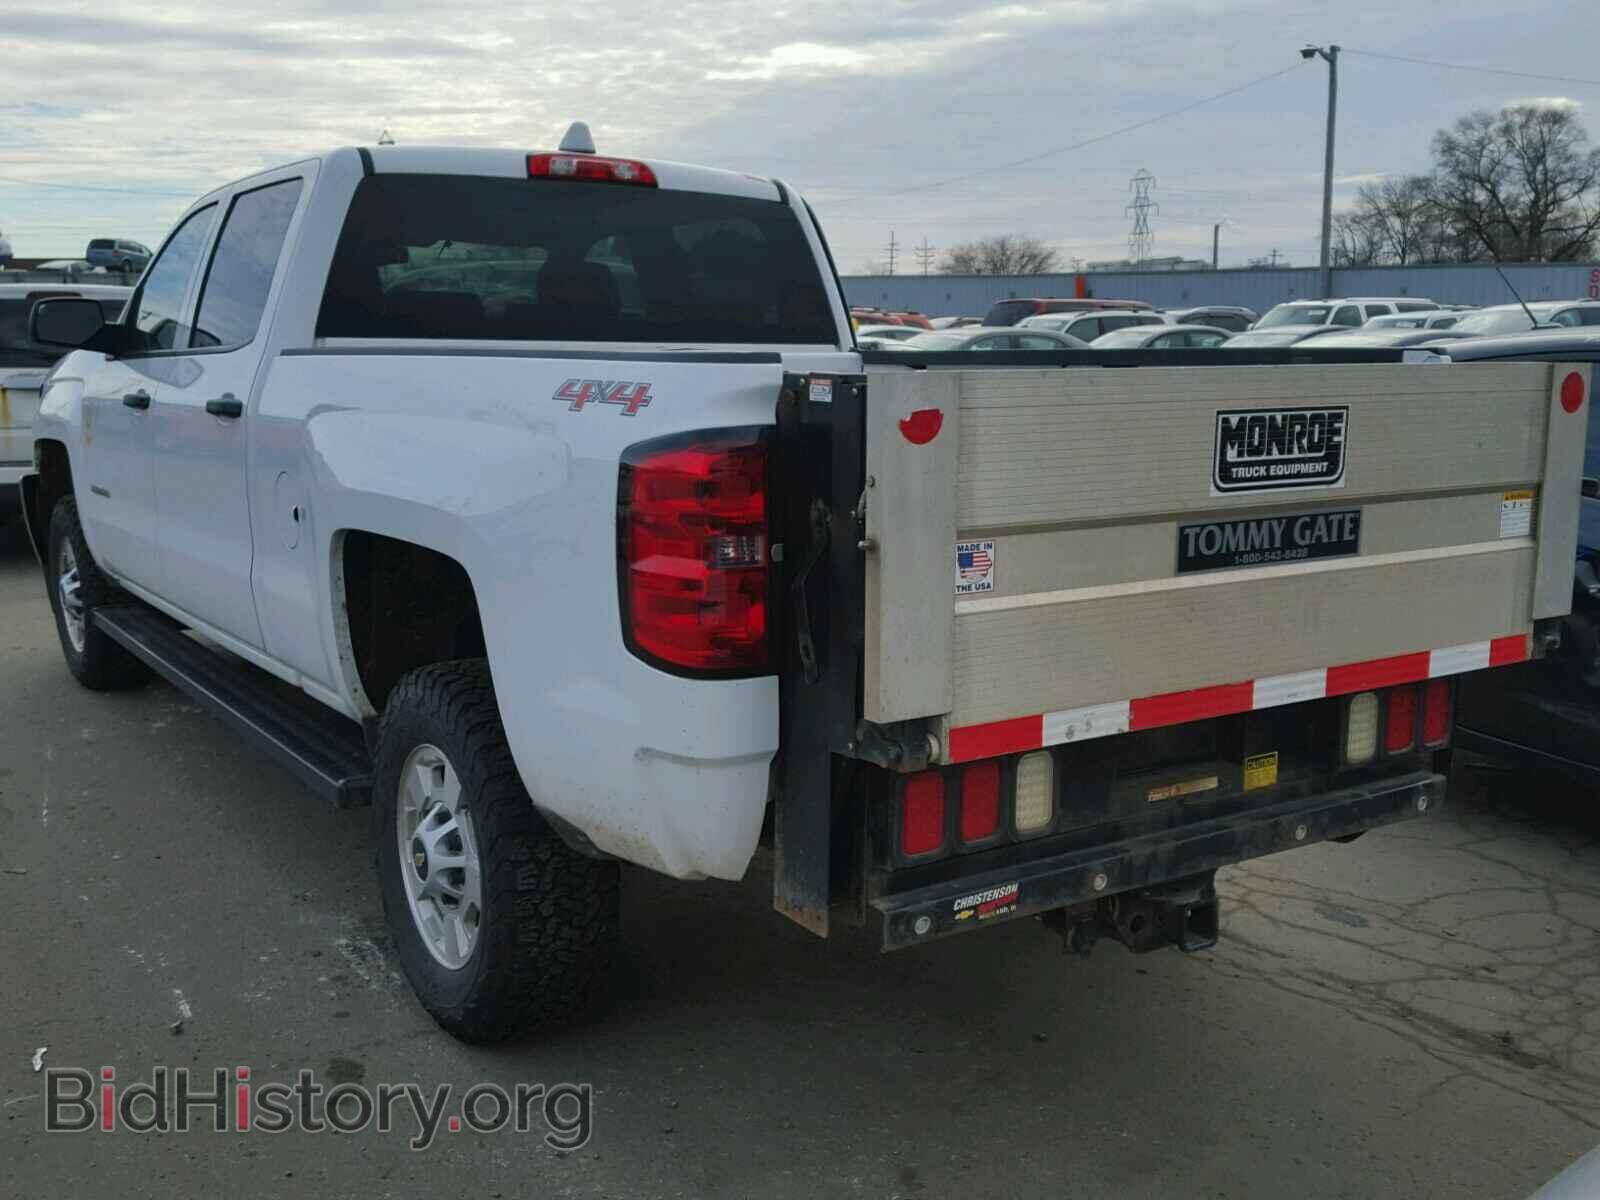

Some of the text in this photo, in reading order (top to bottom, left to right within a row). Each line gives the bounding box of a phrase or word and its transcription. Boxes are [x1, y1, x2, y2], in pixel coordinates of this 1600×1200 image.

[1221, 411, 1345, 458] MONROE
[1231, 461, 1329, 479] TRUCK EQUIPMENT
[1183, 511, 1357, 558] TOMMY GATE
[957, 542, 993, 552] MADE IN
[956, 582, 992, 592] THE USA
[953, 883, 1019, 911] CHRISTENSON
